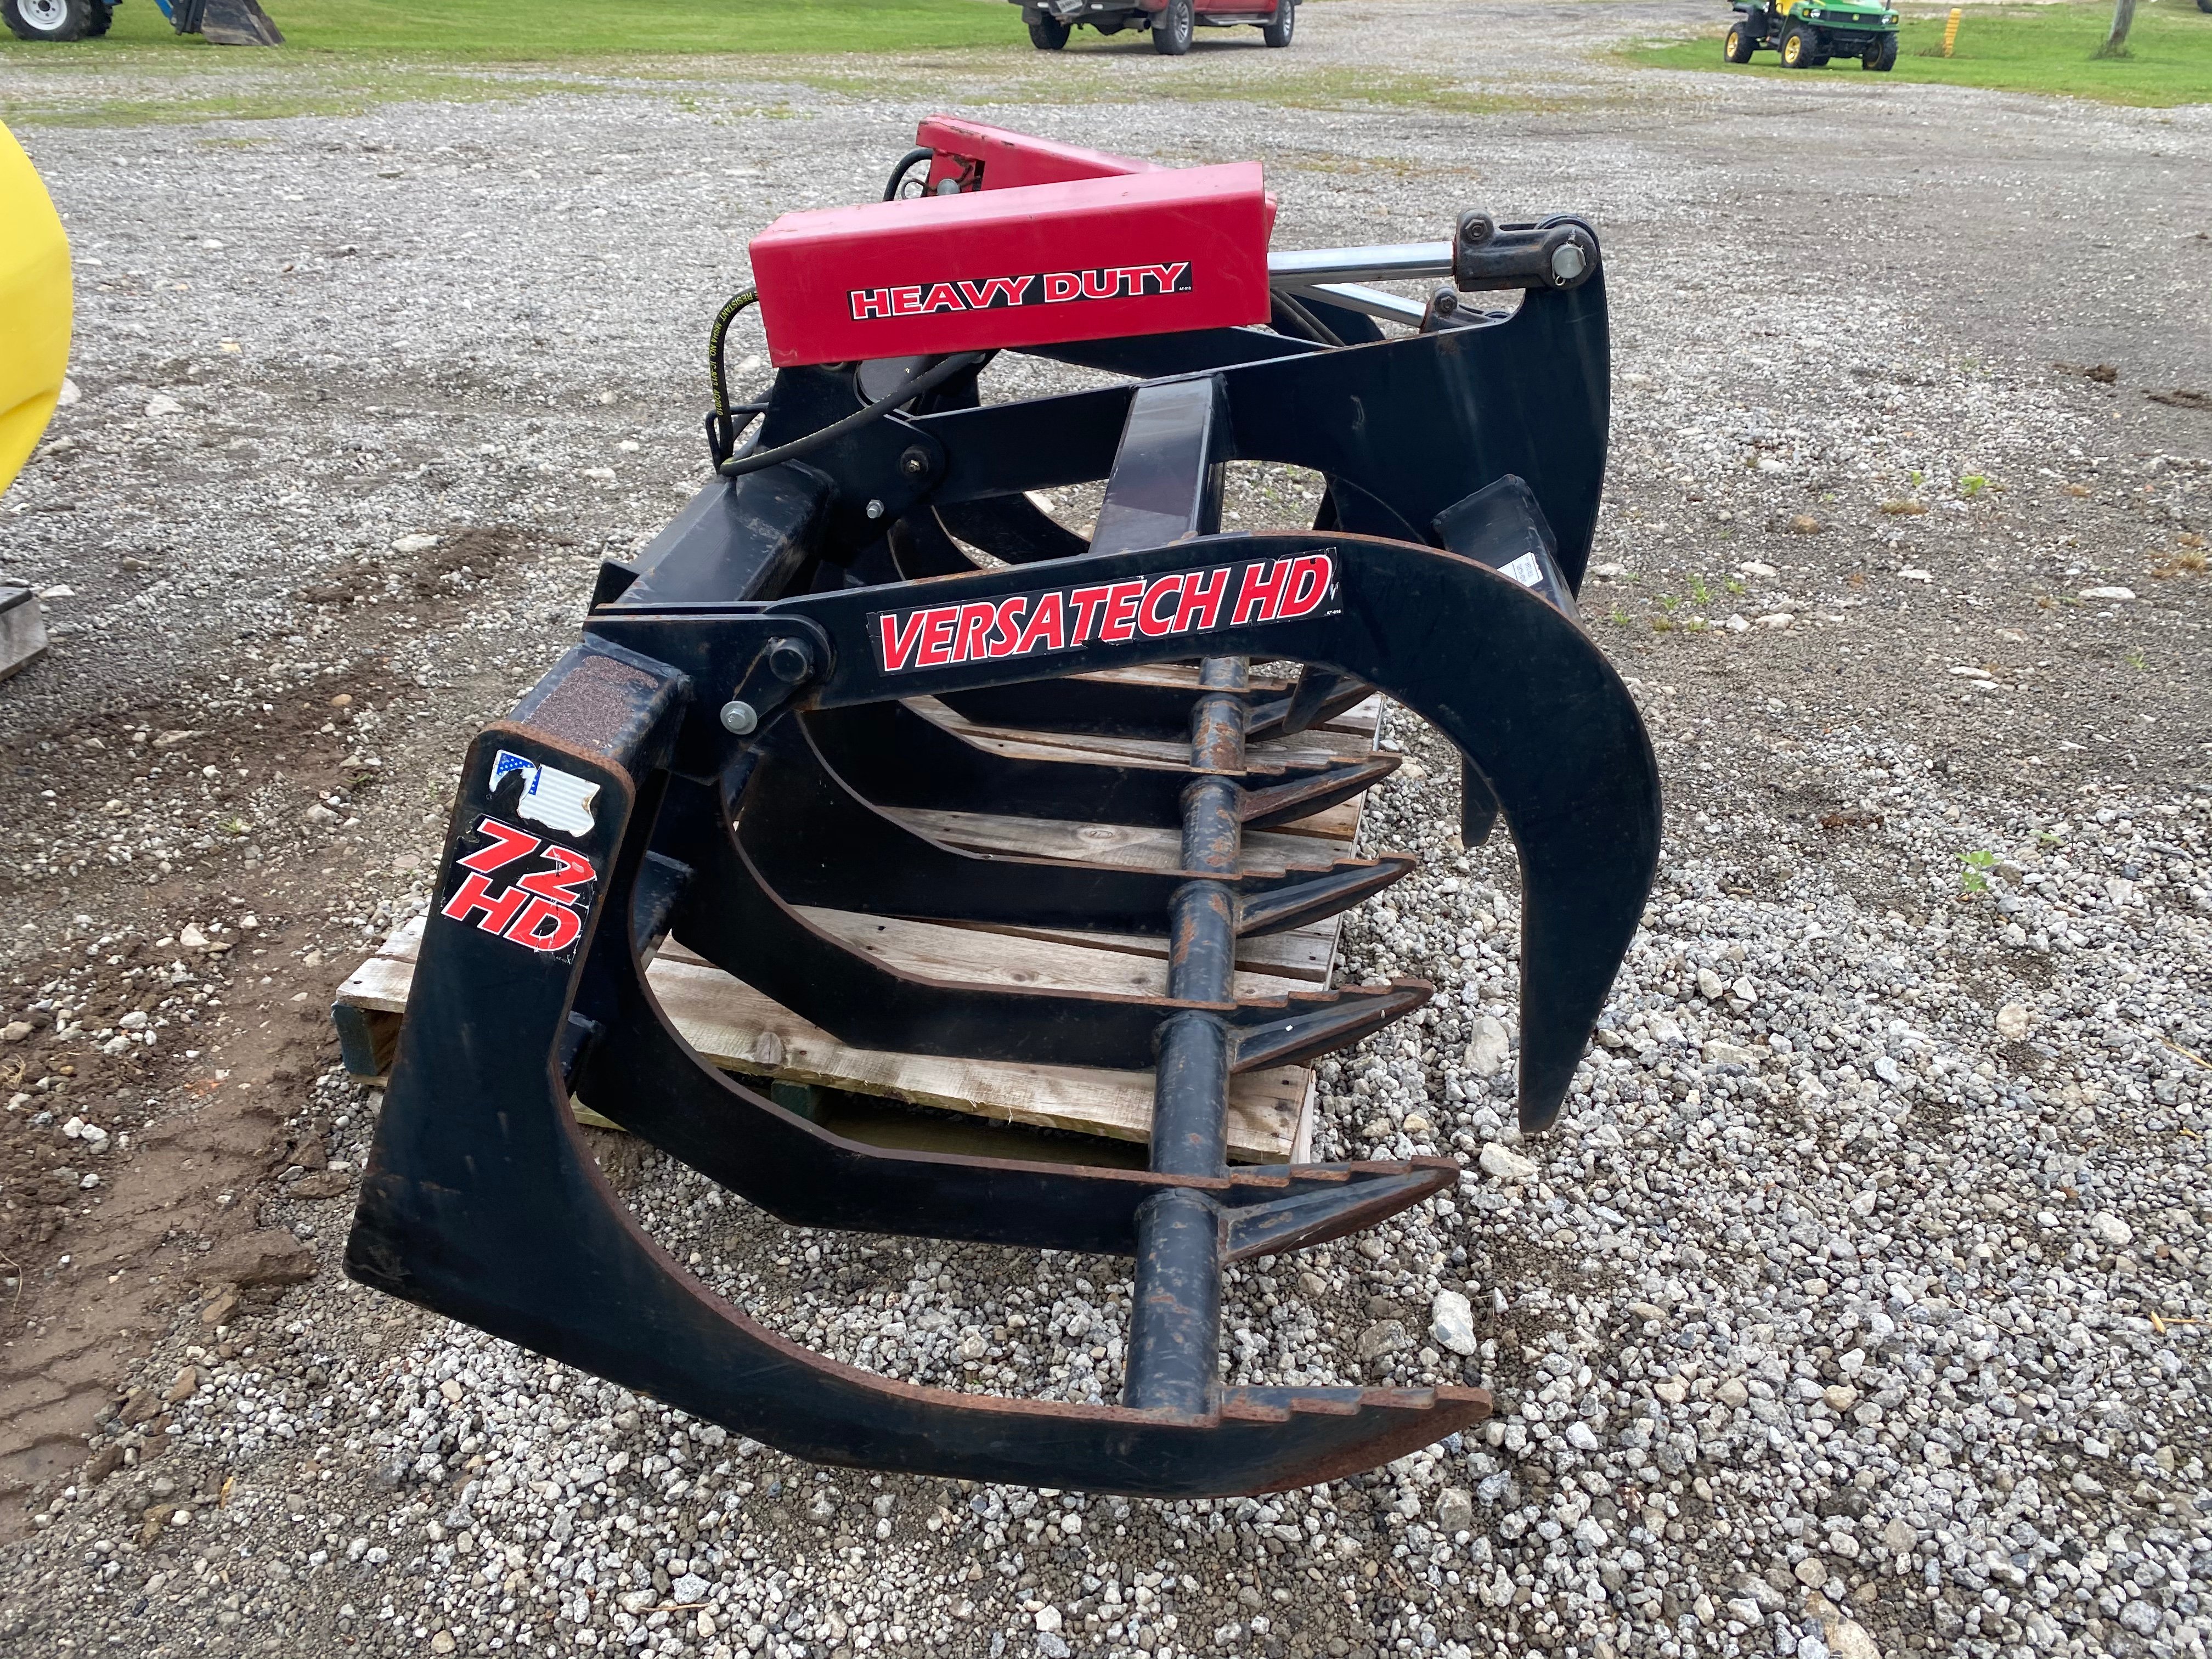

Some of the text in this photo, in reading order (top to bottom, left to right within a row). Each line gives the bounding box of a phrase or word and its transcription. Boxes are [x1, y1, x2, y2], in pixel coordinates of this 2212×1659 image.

[719, 292, 753, 322] RESISTANT
[851, 262, 1189, 319] HEAVY DUTY
[711, 321, 723, 343] MSHA
[879, 554, 1333, 672] VERSATECH HD
[456, 817, 597, 906] 72
[441, 871, 582, 952] HD
